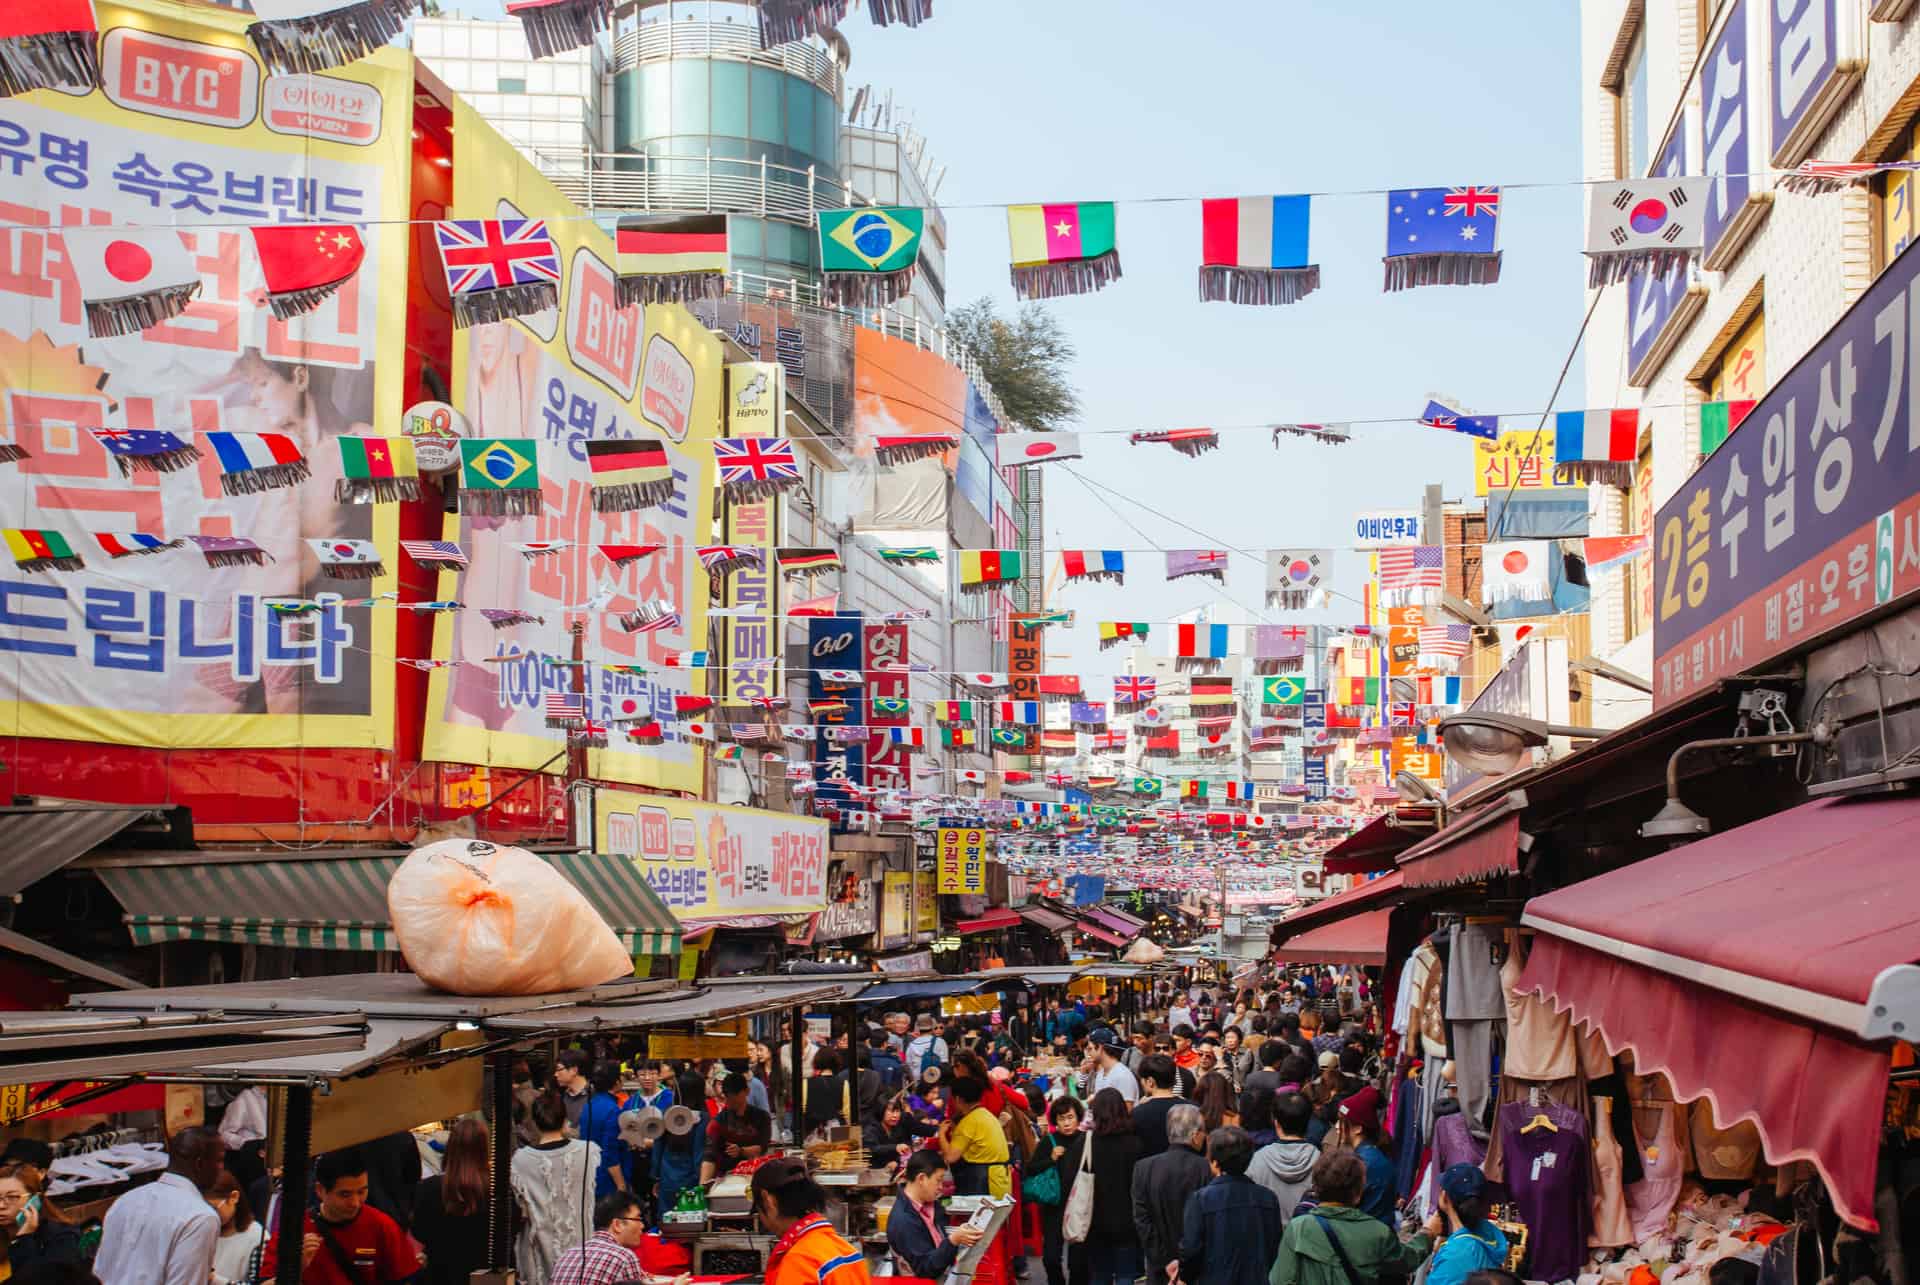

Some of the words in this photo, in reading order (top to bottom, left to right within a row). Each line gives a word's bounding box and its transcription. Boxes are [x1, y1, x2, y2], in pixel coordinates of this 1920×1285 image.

[0, 119, 89, 190] 유명
[113, 152, 364, 224] 속옷브랜드
[585, 293, 629, 369] BYC
[412, 408, 452, 437] BBQ
[1484, 455, 1544, 488] 신발
[1357, 517, 1418, 539] 이비인후과
[1660, 487, 1711, 623] 2층
[0, 580, 347, 677] 드립니다
[771, 831, 822, 897] 폐점전
